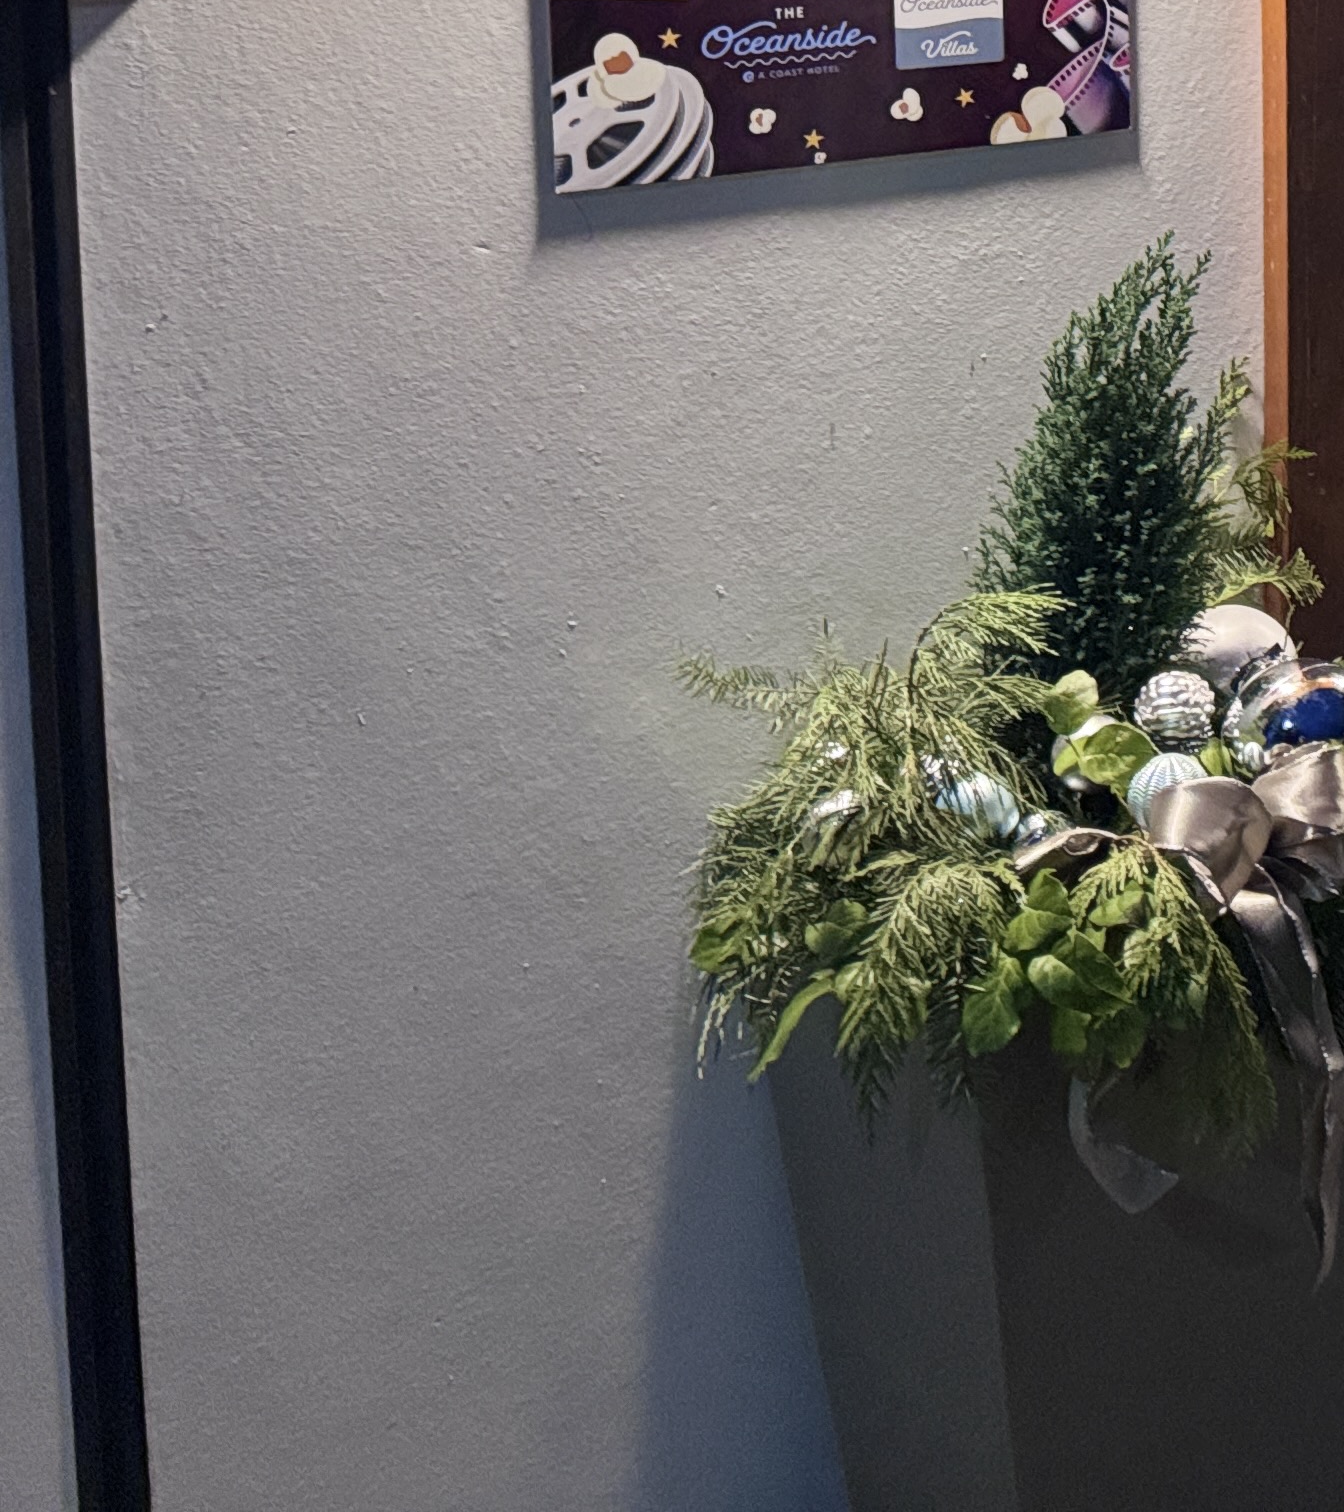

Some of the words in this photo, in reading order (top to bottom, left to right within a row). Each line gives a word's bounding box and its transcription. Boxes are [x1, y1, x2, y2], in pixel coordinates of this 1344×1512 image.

[774, 6, 805, 20] THE
[701, 20, 877, 60] Oceanside
[920, 30, 979, 59] Villas
[769, 68, 804, 80] COAST
